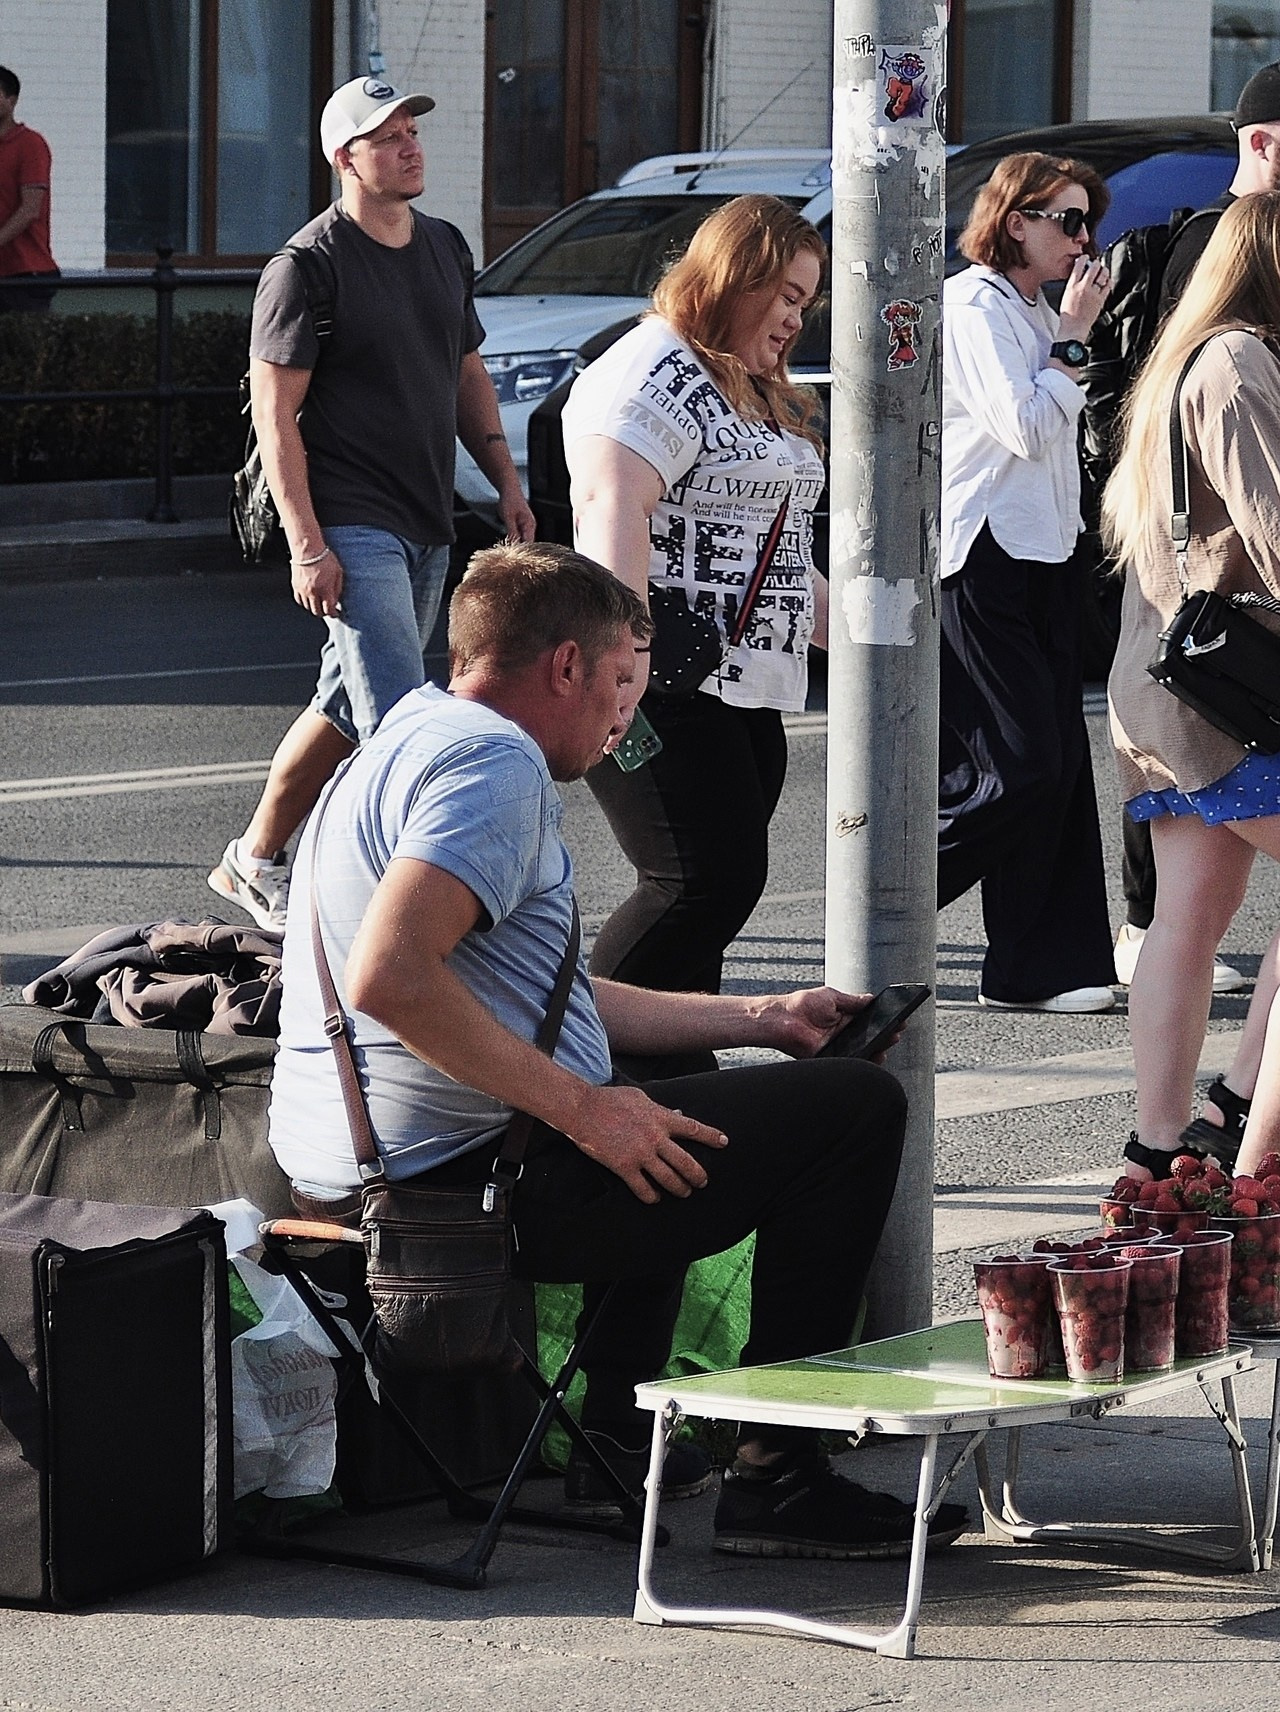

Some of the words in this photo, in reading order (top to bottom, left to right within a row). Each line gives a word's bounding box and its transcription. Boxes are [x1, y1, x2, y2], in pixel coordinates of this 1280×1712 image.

[691, 508, 711, 517] And
[713, 510, 730, 519] will
[733, 512, 745, 521] he
